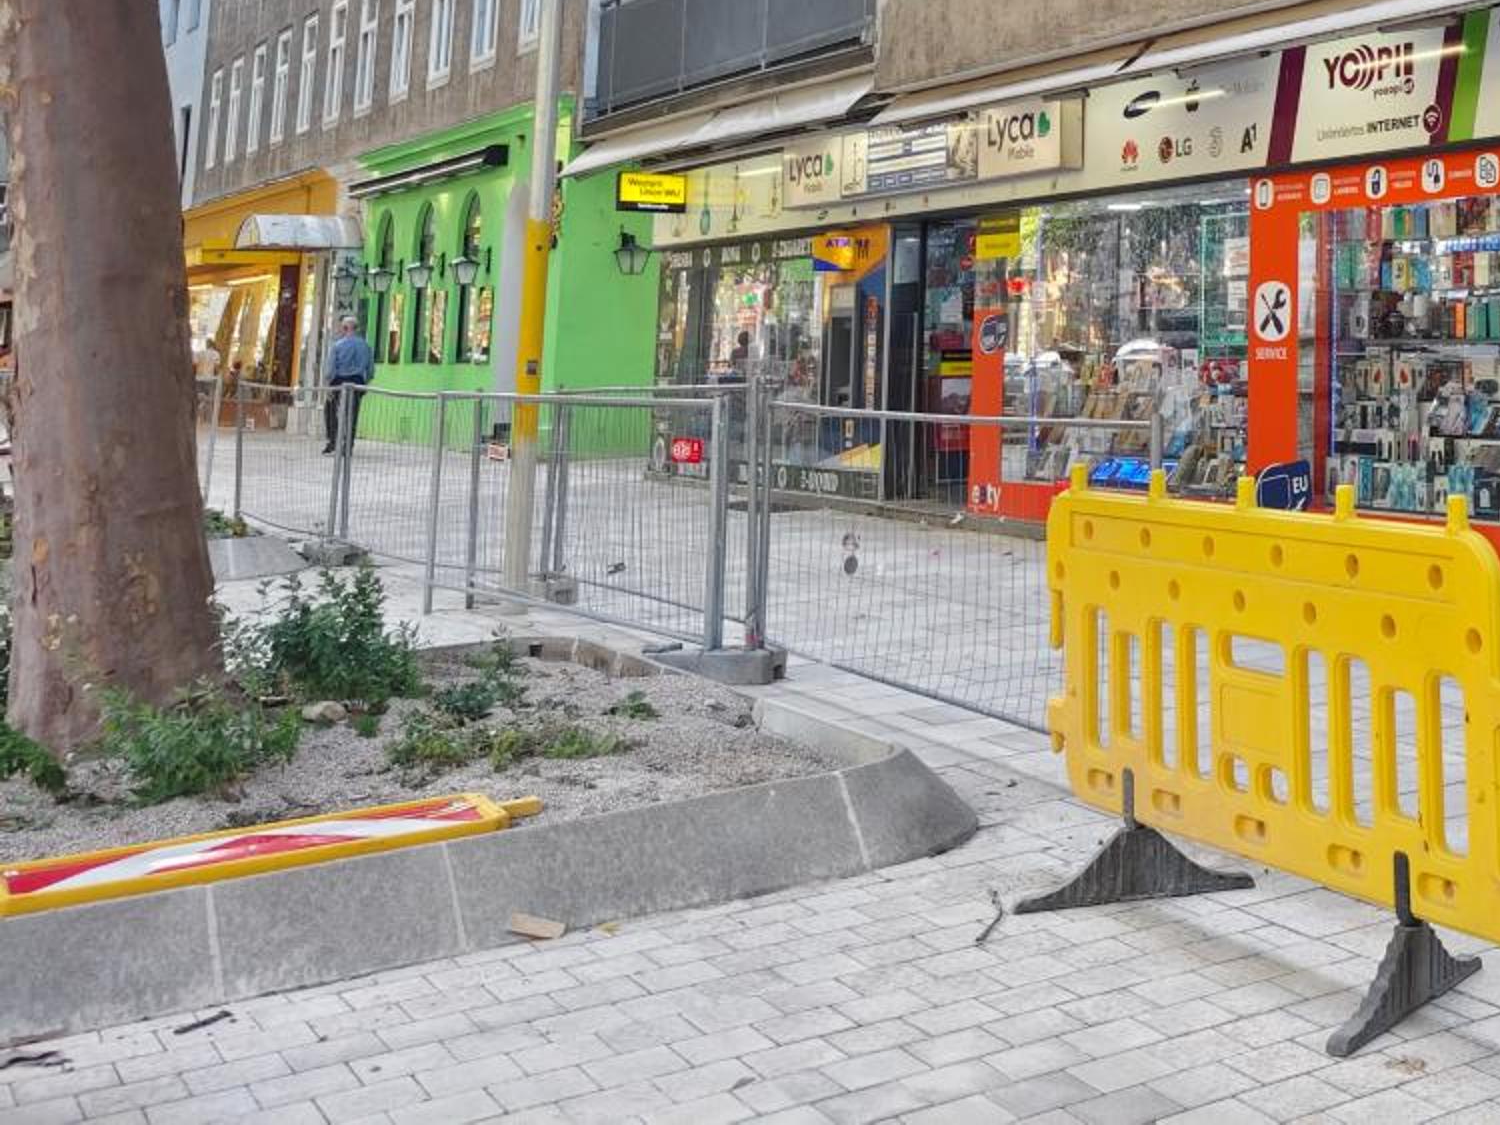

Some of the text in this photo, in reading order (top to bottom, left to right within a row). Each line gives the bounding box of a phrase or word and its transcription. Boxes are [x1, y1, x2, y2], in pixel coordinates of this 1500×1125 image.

[986, 112, 1035, 152] Lyca
[1366, 115, 1420, 135] INTERNET
[1240, 123, 1257, 154] A1
[789, 153, 823, 182] Lyca
[1255, 346, 1288, 360] SERVICE
[1292, 475, 1309, 494] EU
